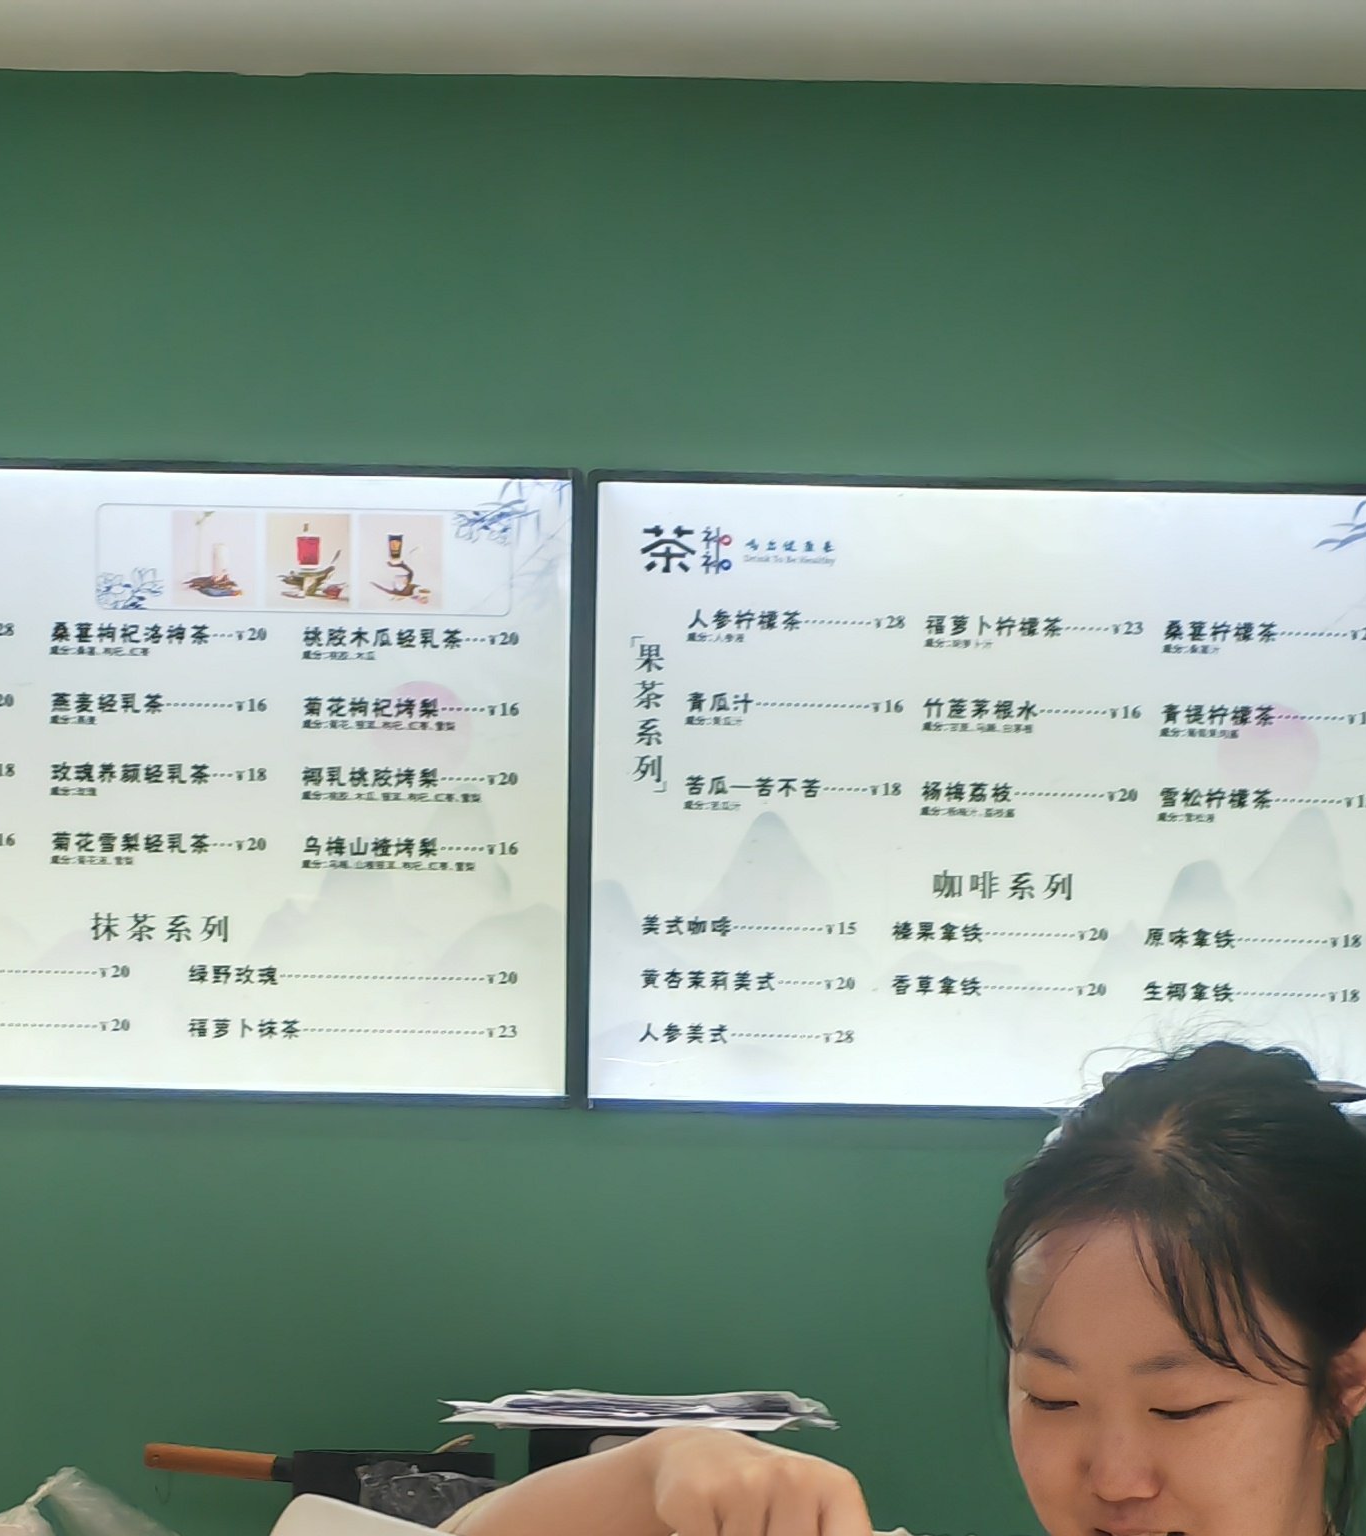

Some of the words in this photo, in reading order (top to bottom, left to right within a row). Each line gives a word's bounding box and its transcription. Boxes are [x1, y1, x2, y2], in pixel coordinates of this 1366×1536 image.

[688, 609, 802, 631] 人参柠檬茶
[302, 626, 463, 649] 桃胶木瓜轻乳茶
[1164, 620, 1277, 643] 桑葚柠檬茶
[51, 692, 163, 713] 燕麦轻乳茶
[303, 697, 438, 718] 菊花枸杞烤梨
[687, 692, 753, 714] 青瓜汁
[1162, 704, 1275, 726] 青提柠檬茶
[51, 762, 210, 784] 玫瑰养颜轻乳茶
[922, 781, 1013, 803] 杨梅荔枝
[1160, 787, 1272, 809] 雪松柠檬茶
[51, 832, 210, 854] 菊花雪梨轻乳茶
[303, 835, 438, 858] 乌梅山楂烤梨
[933, 870, 1073, 900] 咖啡系列
[91, 912, 230, 943] 抹茶系列
[641, 914, 732, 937] 美式咖啡
[892, 921, 984, 942] 榛果拿铁
[1144, 927, 1236, 949] 原味拿铁
[188, 965, 278, 985] 绿野玫瑰
[891, 975, 982, 996] 香草拿铁
[1143, 981, 1234, 1002] 生椰拿铁
[640, 1023, 728, 1045] 人参美式
